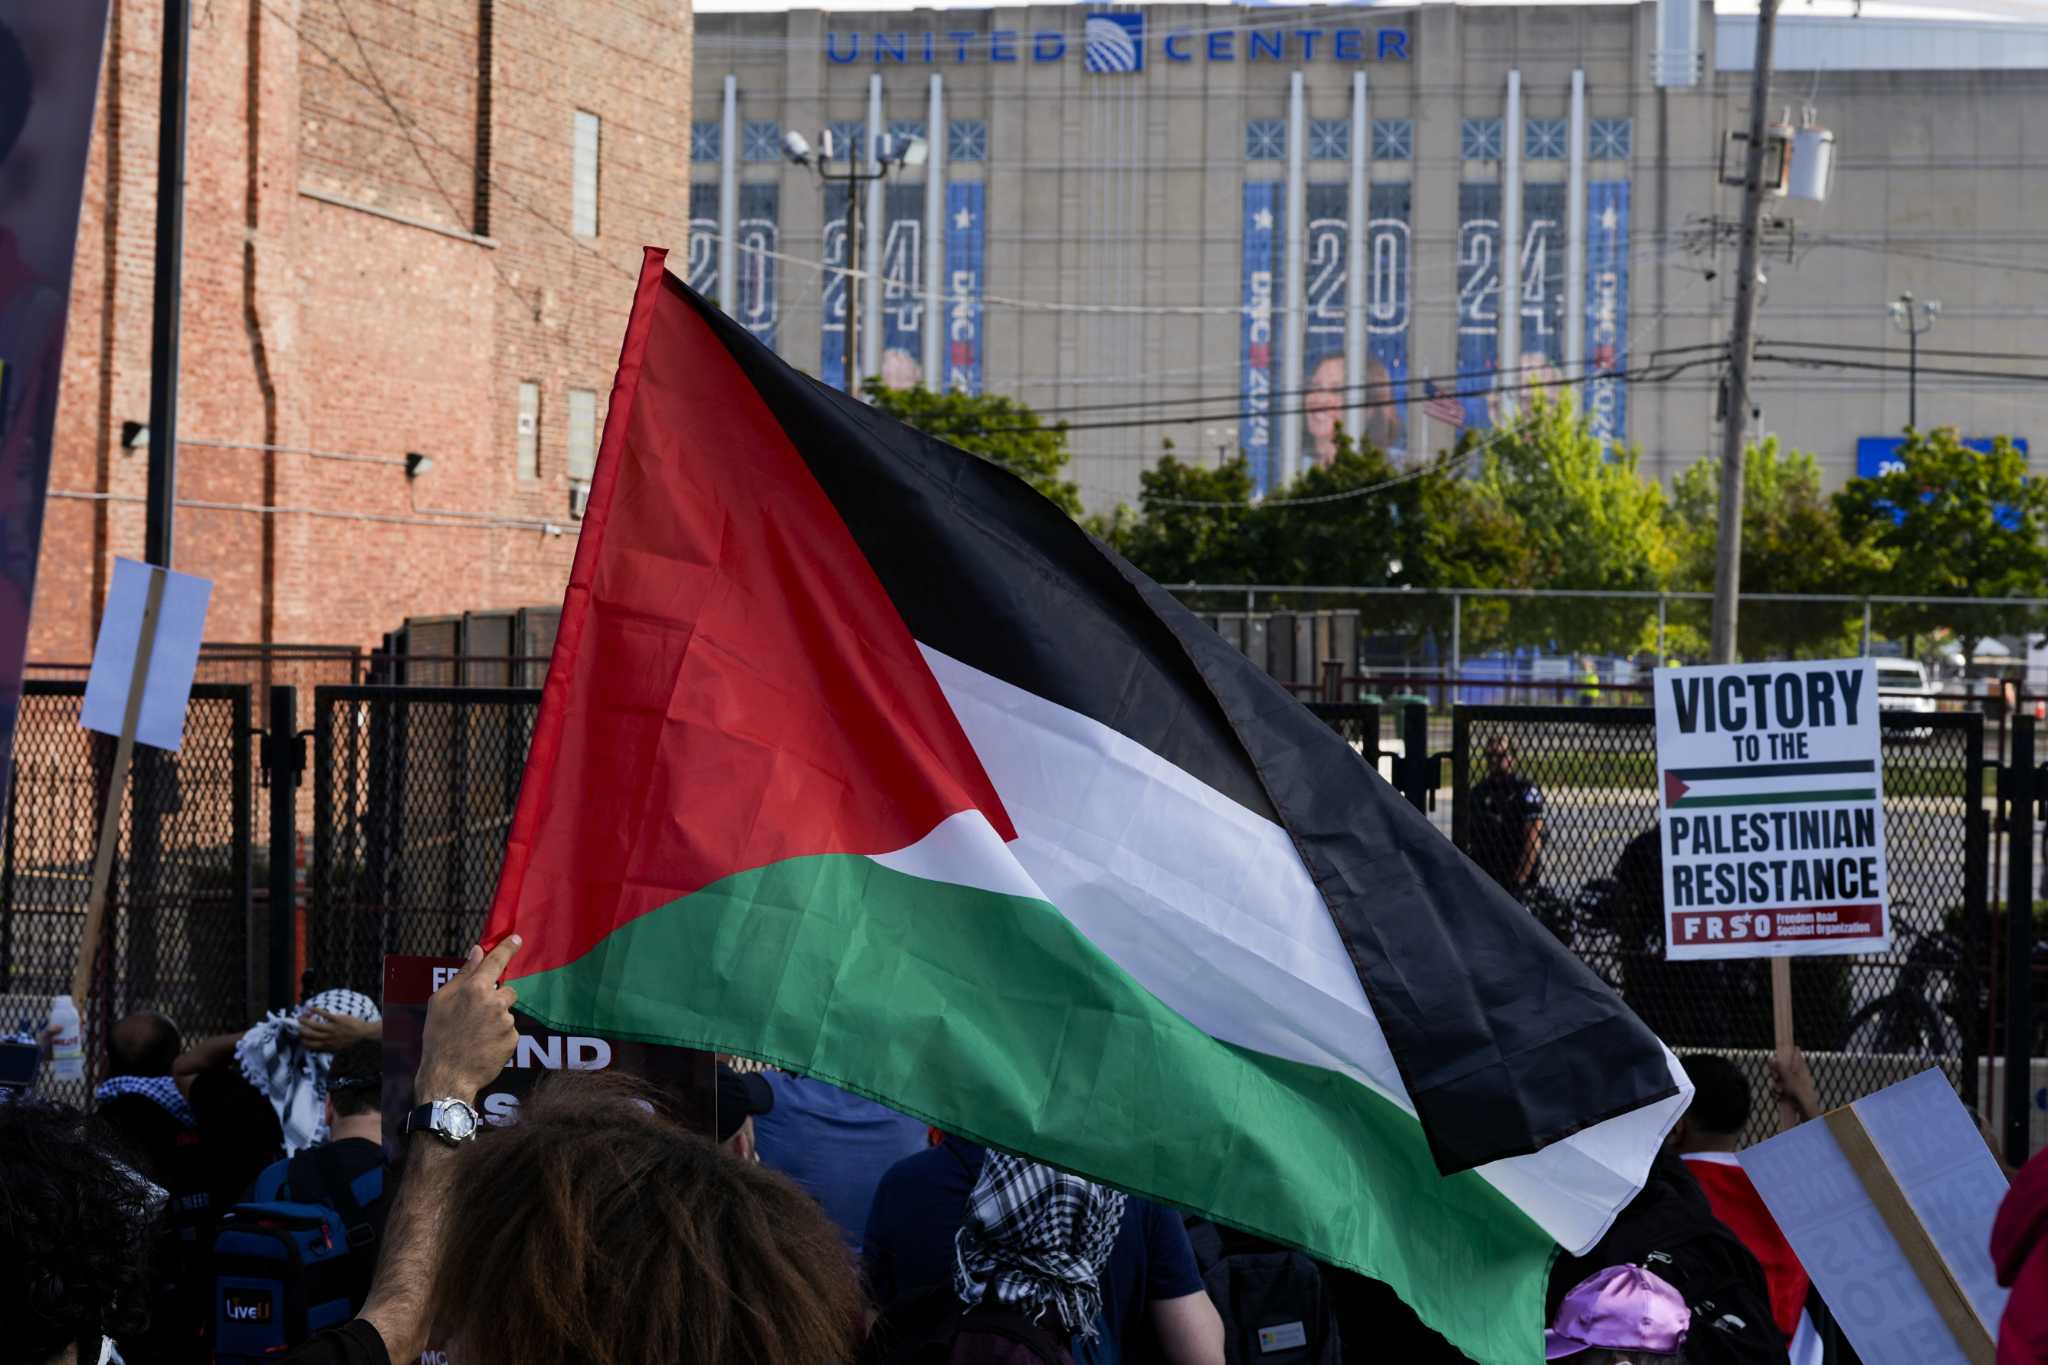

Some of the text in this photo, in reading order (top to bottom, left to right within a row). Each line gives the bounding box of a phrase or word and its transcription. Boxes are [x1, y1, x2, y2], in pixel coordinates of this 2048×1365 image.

[827, 26, 1410, 64] UNITED CENTER
[1250, 271, 1272, 344] DNC
[1671, 669, 1863, 734] VICTORY
[1732, 732, 1809, 762] TO THE
[1669, 808, 1876, 856] PALESTINIAN
[1671, 856, 1879, 907] RESISTANCE
[1683, 913, 1771, 940] FRSO
[503, 1034, 612, 1071] ND
[226, 1297, 270, 1320] LiveU
